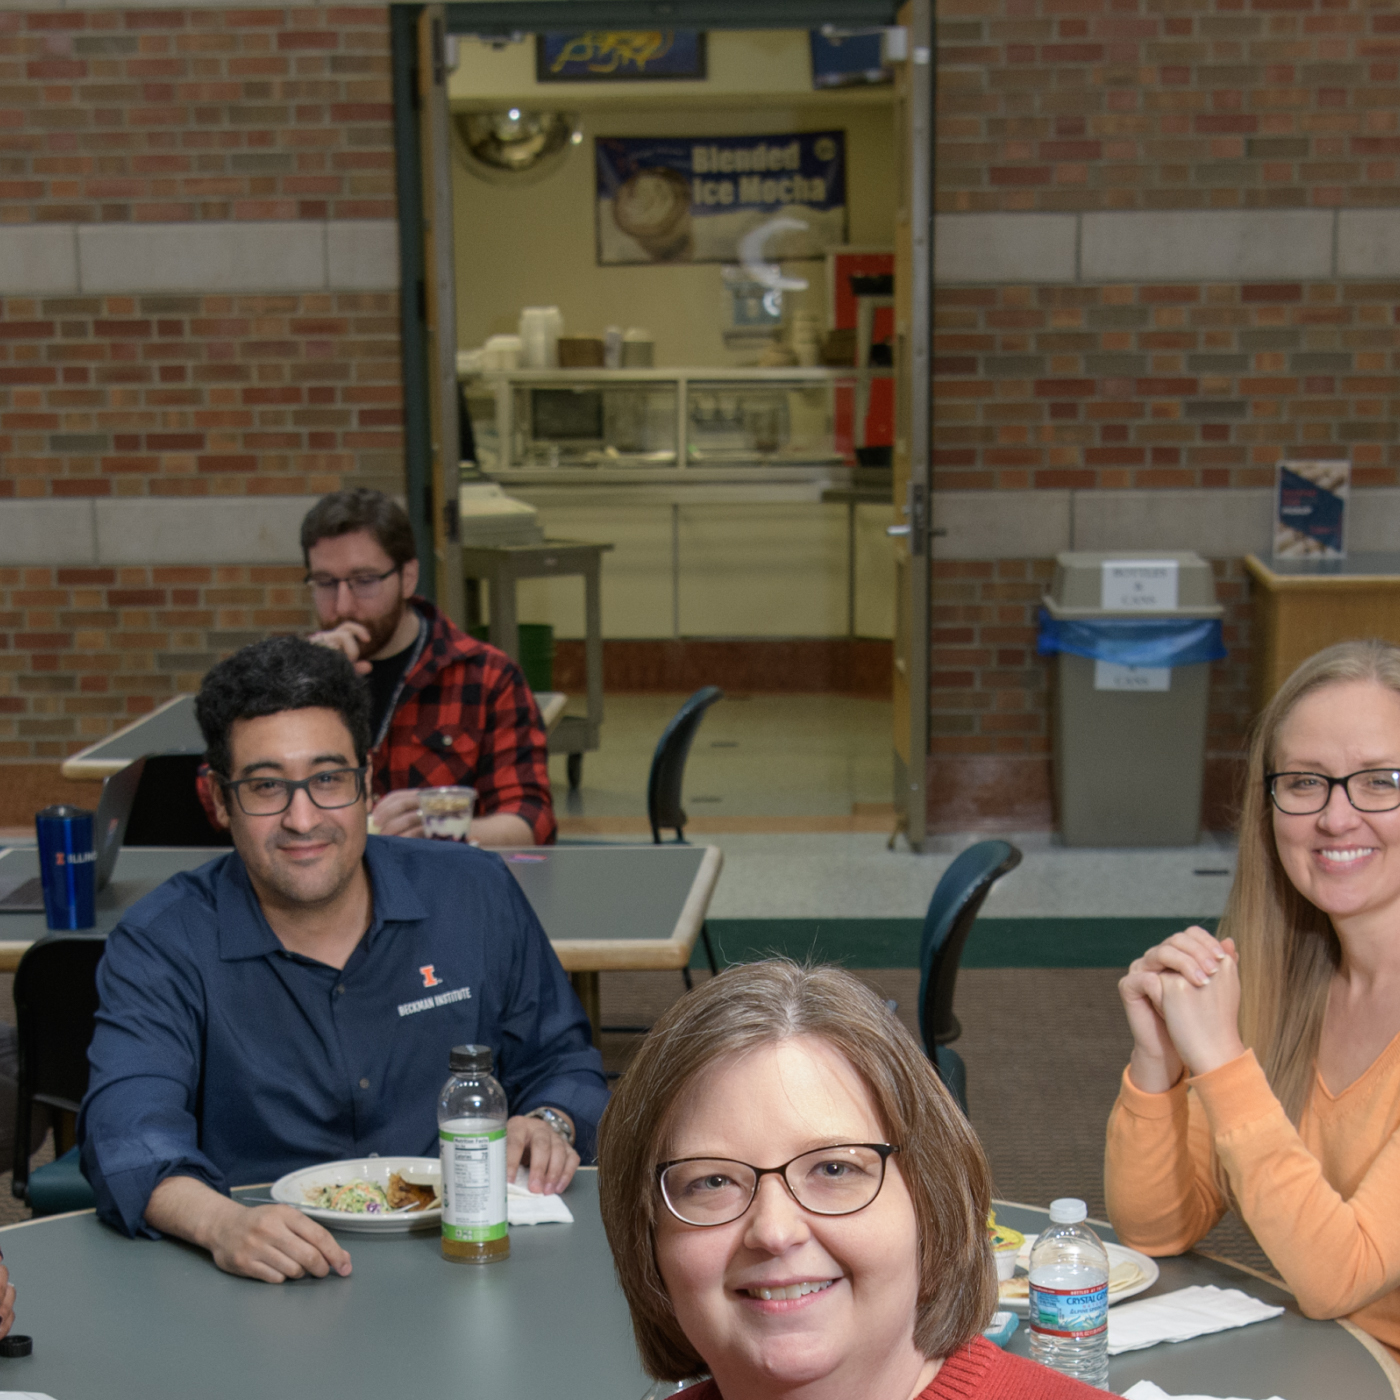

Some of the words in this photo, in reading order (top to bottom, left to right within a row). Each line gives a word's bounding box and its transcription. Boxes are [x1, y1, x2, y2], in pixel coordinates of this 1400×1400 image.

[692, 142, 800, 172] Blended
[692, 177, 735, 205] Ice
[739, 174, 826, 204] Mocha
[397, 996, 436, 1017] BECKMAN
[434, 986, 472, 1006] INSTITUTE
[1066, 1295, 1096, 1305] CRYSTAL
